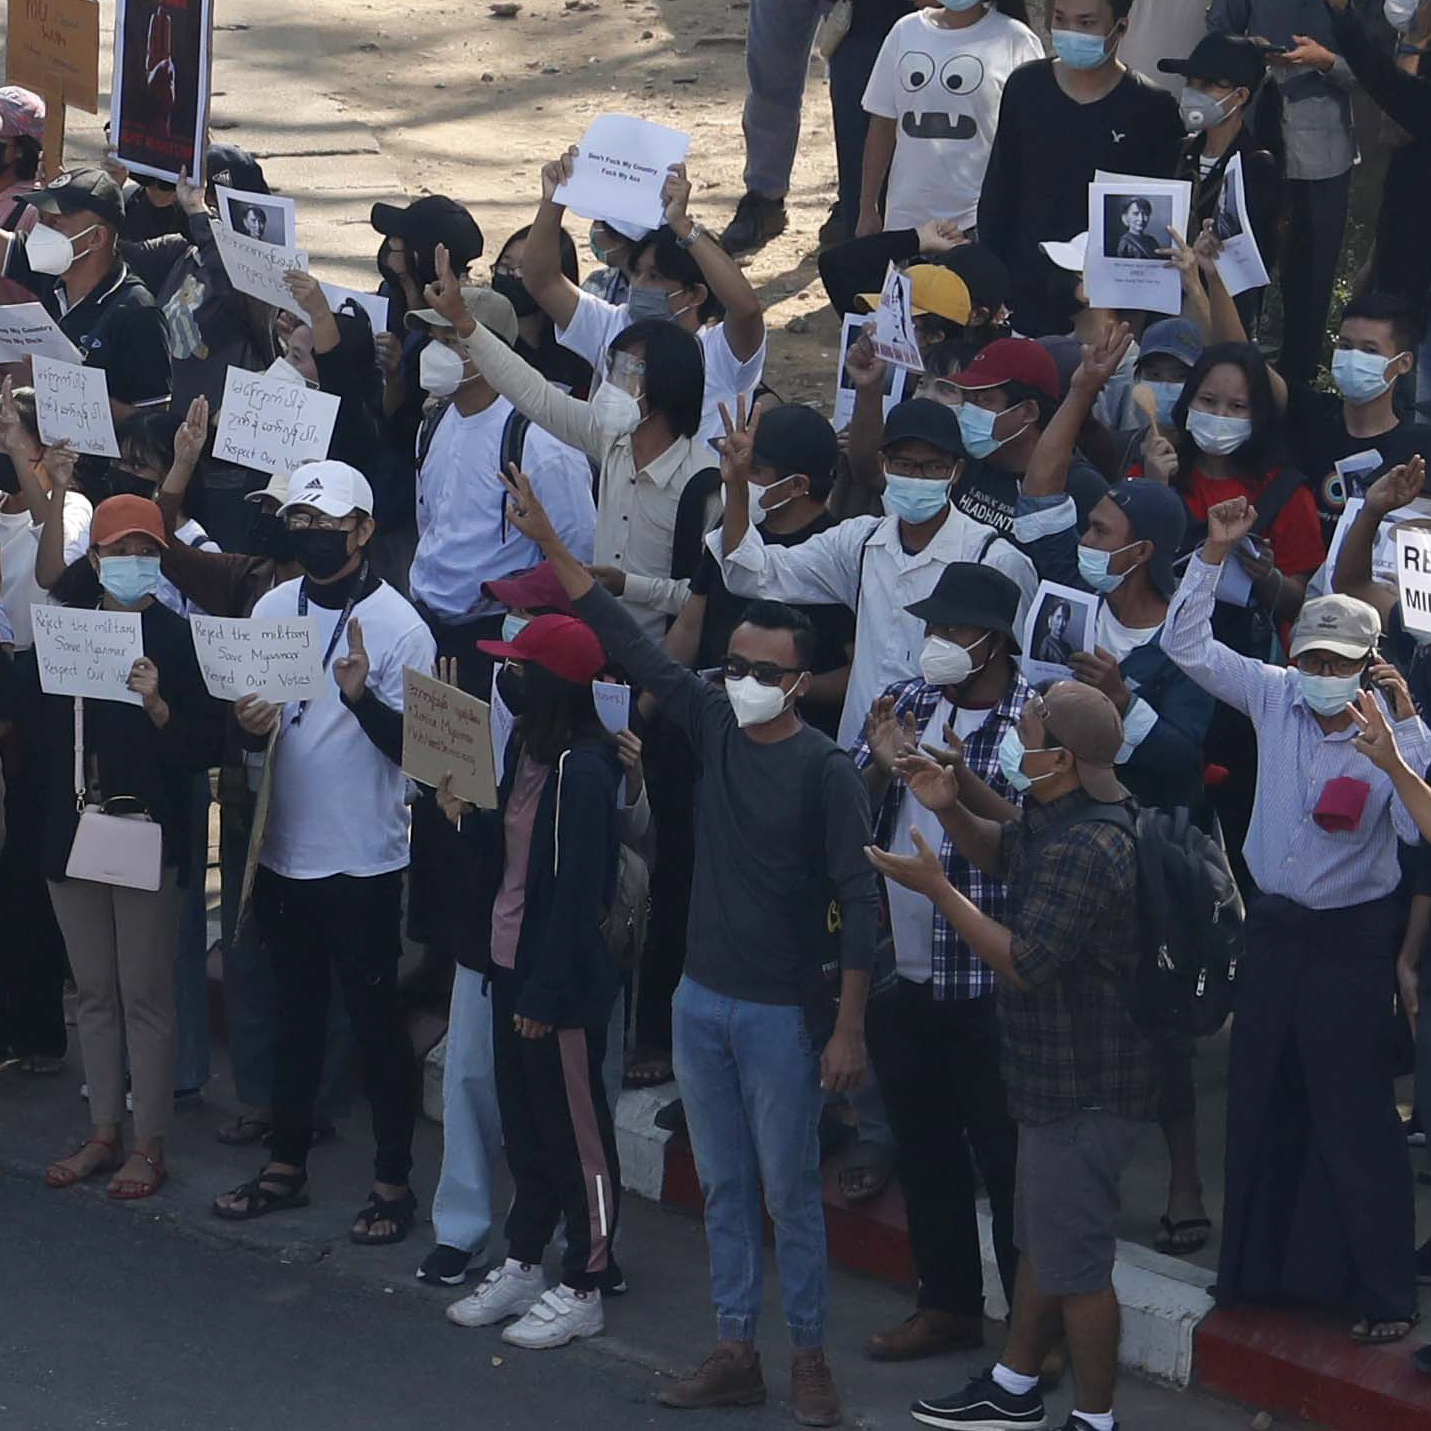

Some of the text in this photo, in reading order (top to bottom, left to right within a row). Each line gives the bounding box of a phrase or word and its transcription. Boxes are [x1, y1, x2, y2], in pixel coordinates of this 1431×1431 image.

[618, 172, 629, 181] My
[622, 160, 633, 170] My
[221, 435, 257, 460] Respect
[260, 448, 277, 465] Our
[36, 611, 137, 645] Reject the military
[231, 622, 251, 642] the
[261, 627, 311, 649] military
[53, 635, 82, 654] Save
[43, 657, 79, 683] Respect
[85, 667, 105, 683] Our
[216, 647, 301, 674] Save Myanmar
[245, 670, 268, 688] Our
